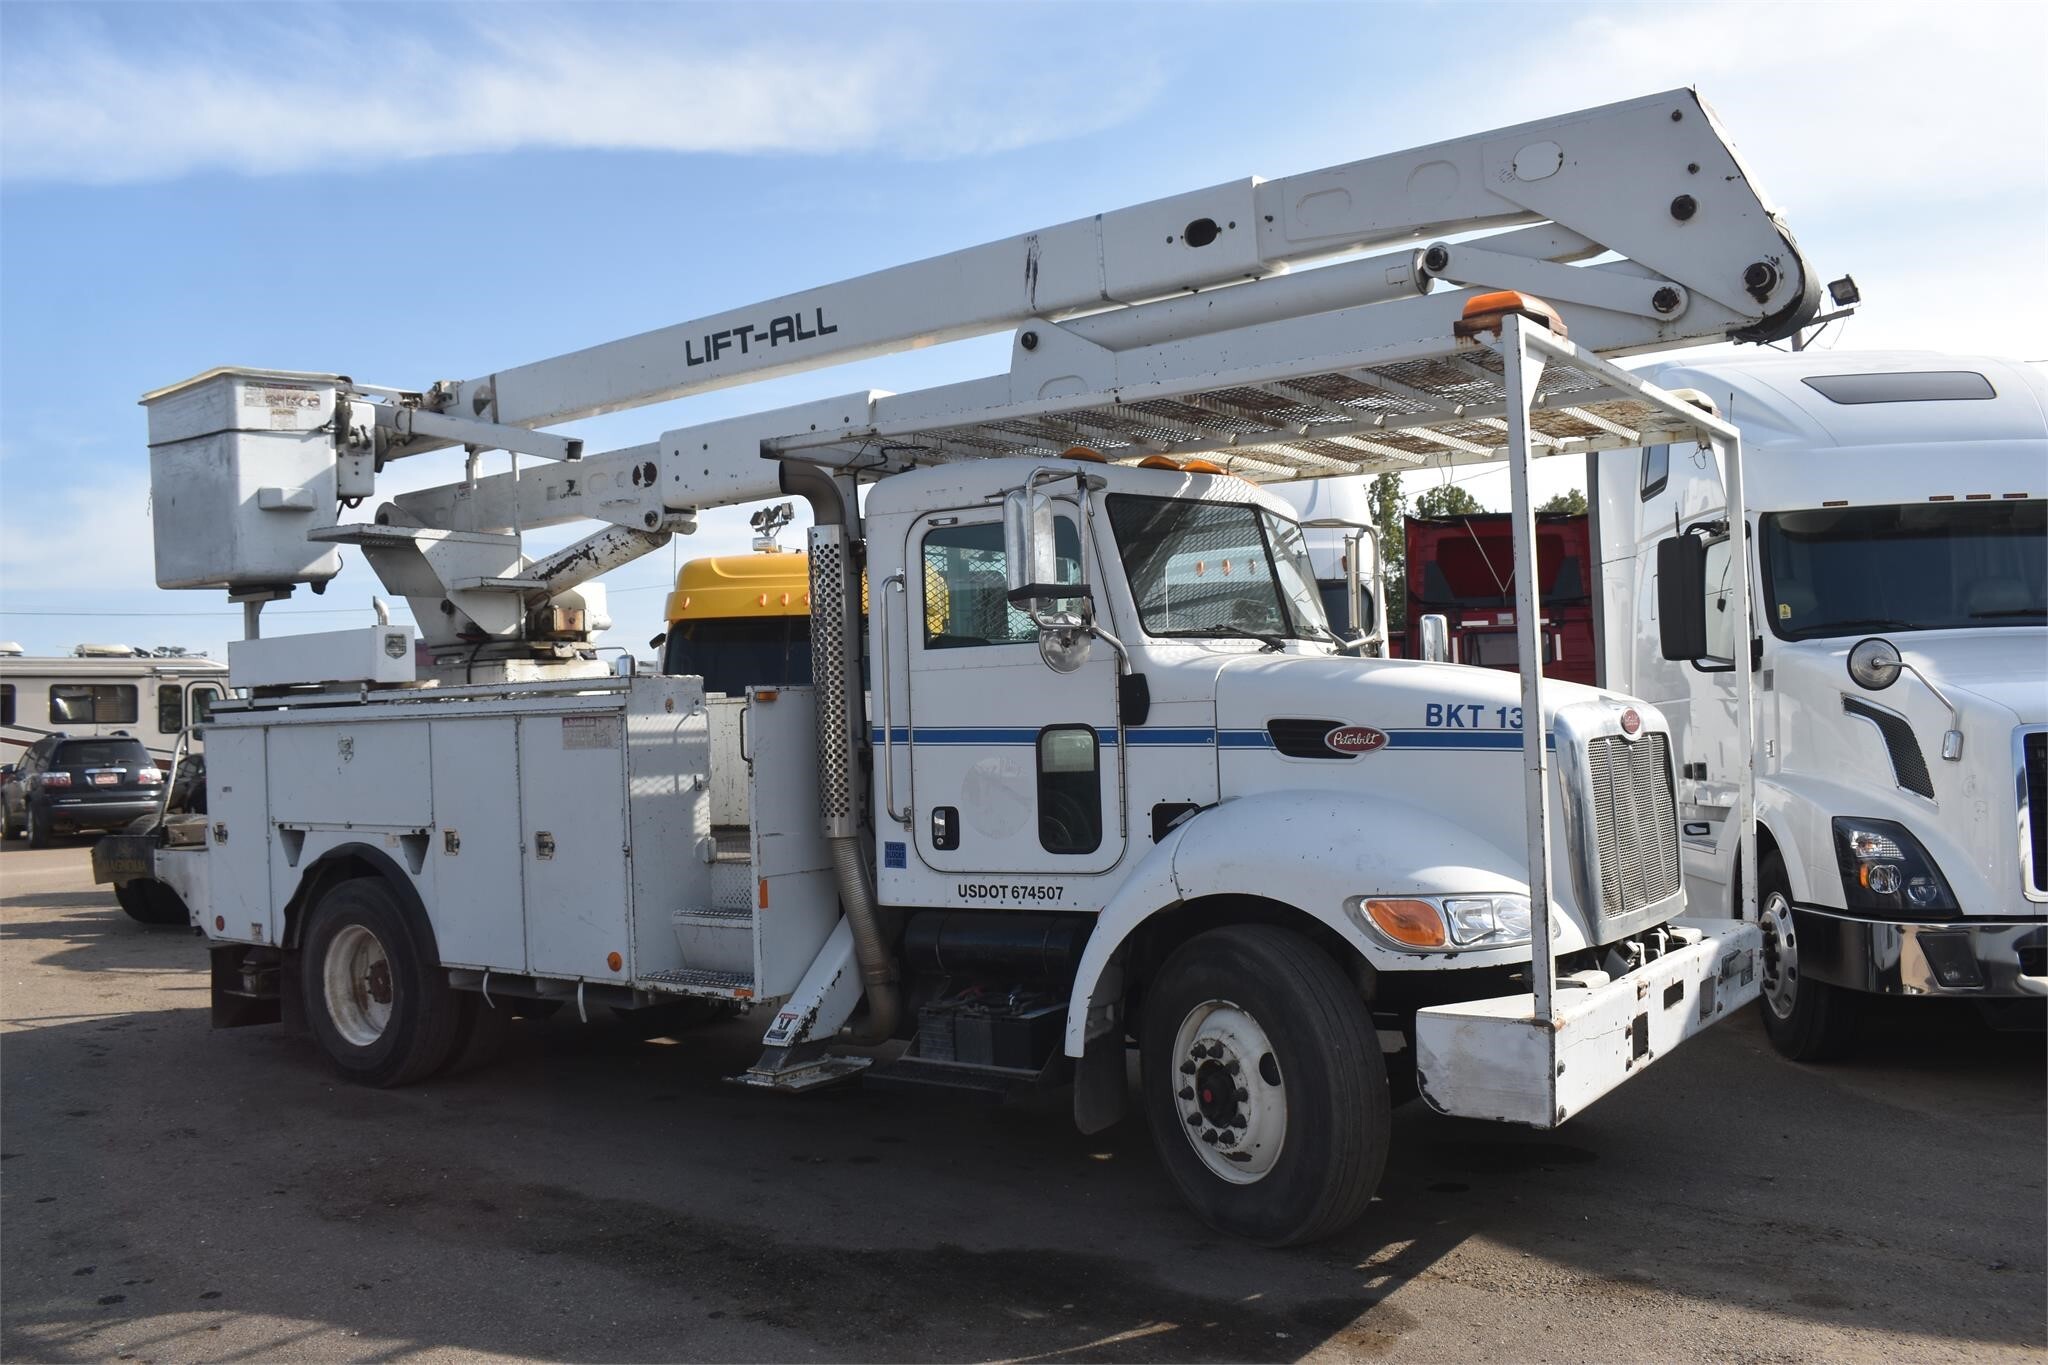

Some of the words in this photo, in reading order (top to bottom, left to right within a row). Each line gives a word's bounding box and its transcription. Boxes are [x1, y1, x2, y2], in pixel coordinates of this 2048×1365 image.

[685, 307, 838, 366] LIFT-ALL
[1425, 703, 1485, 728] BKT
[1496, 706, 1523, 729] 13
[1333, 731, 1381, 746] Peterbilt
[958, 884, 1009, 899] USDOT
[1011, 885, 1064, 900] 674507
